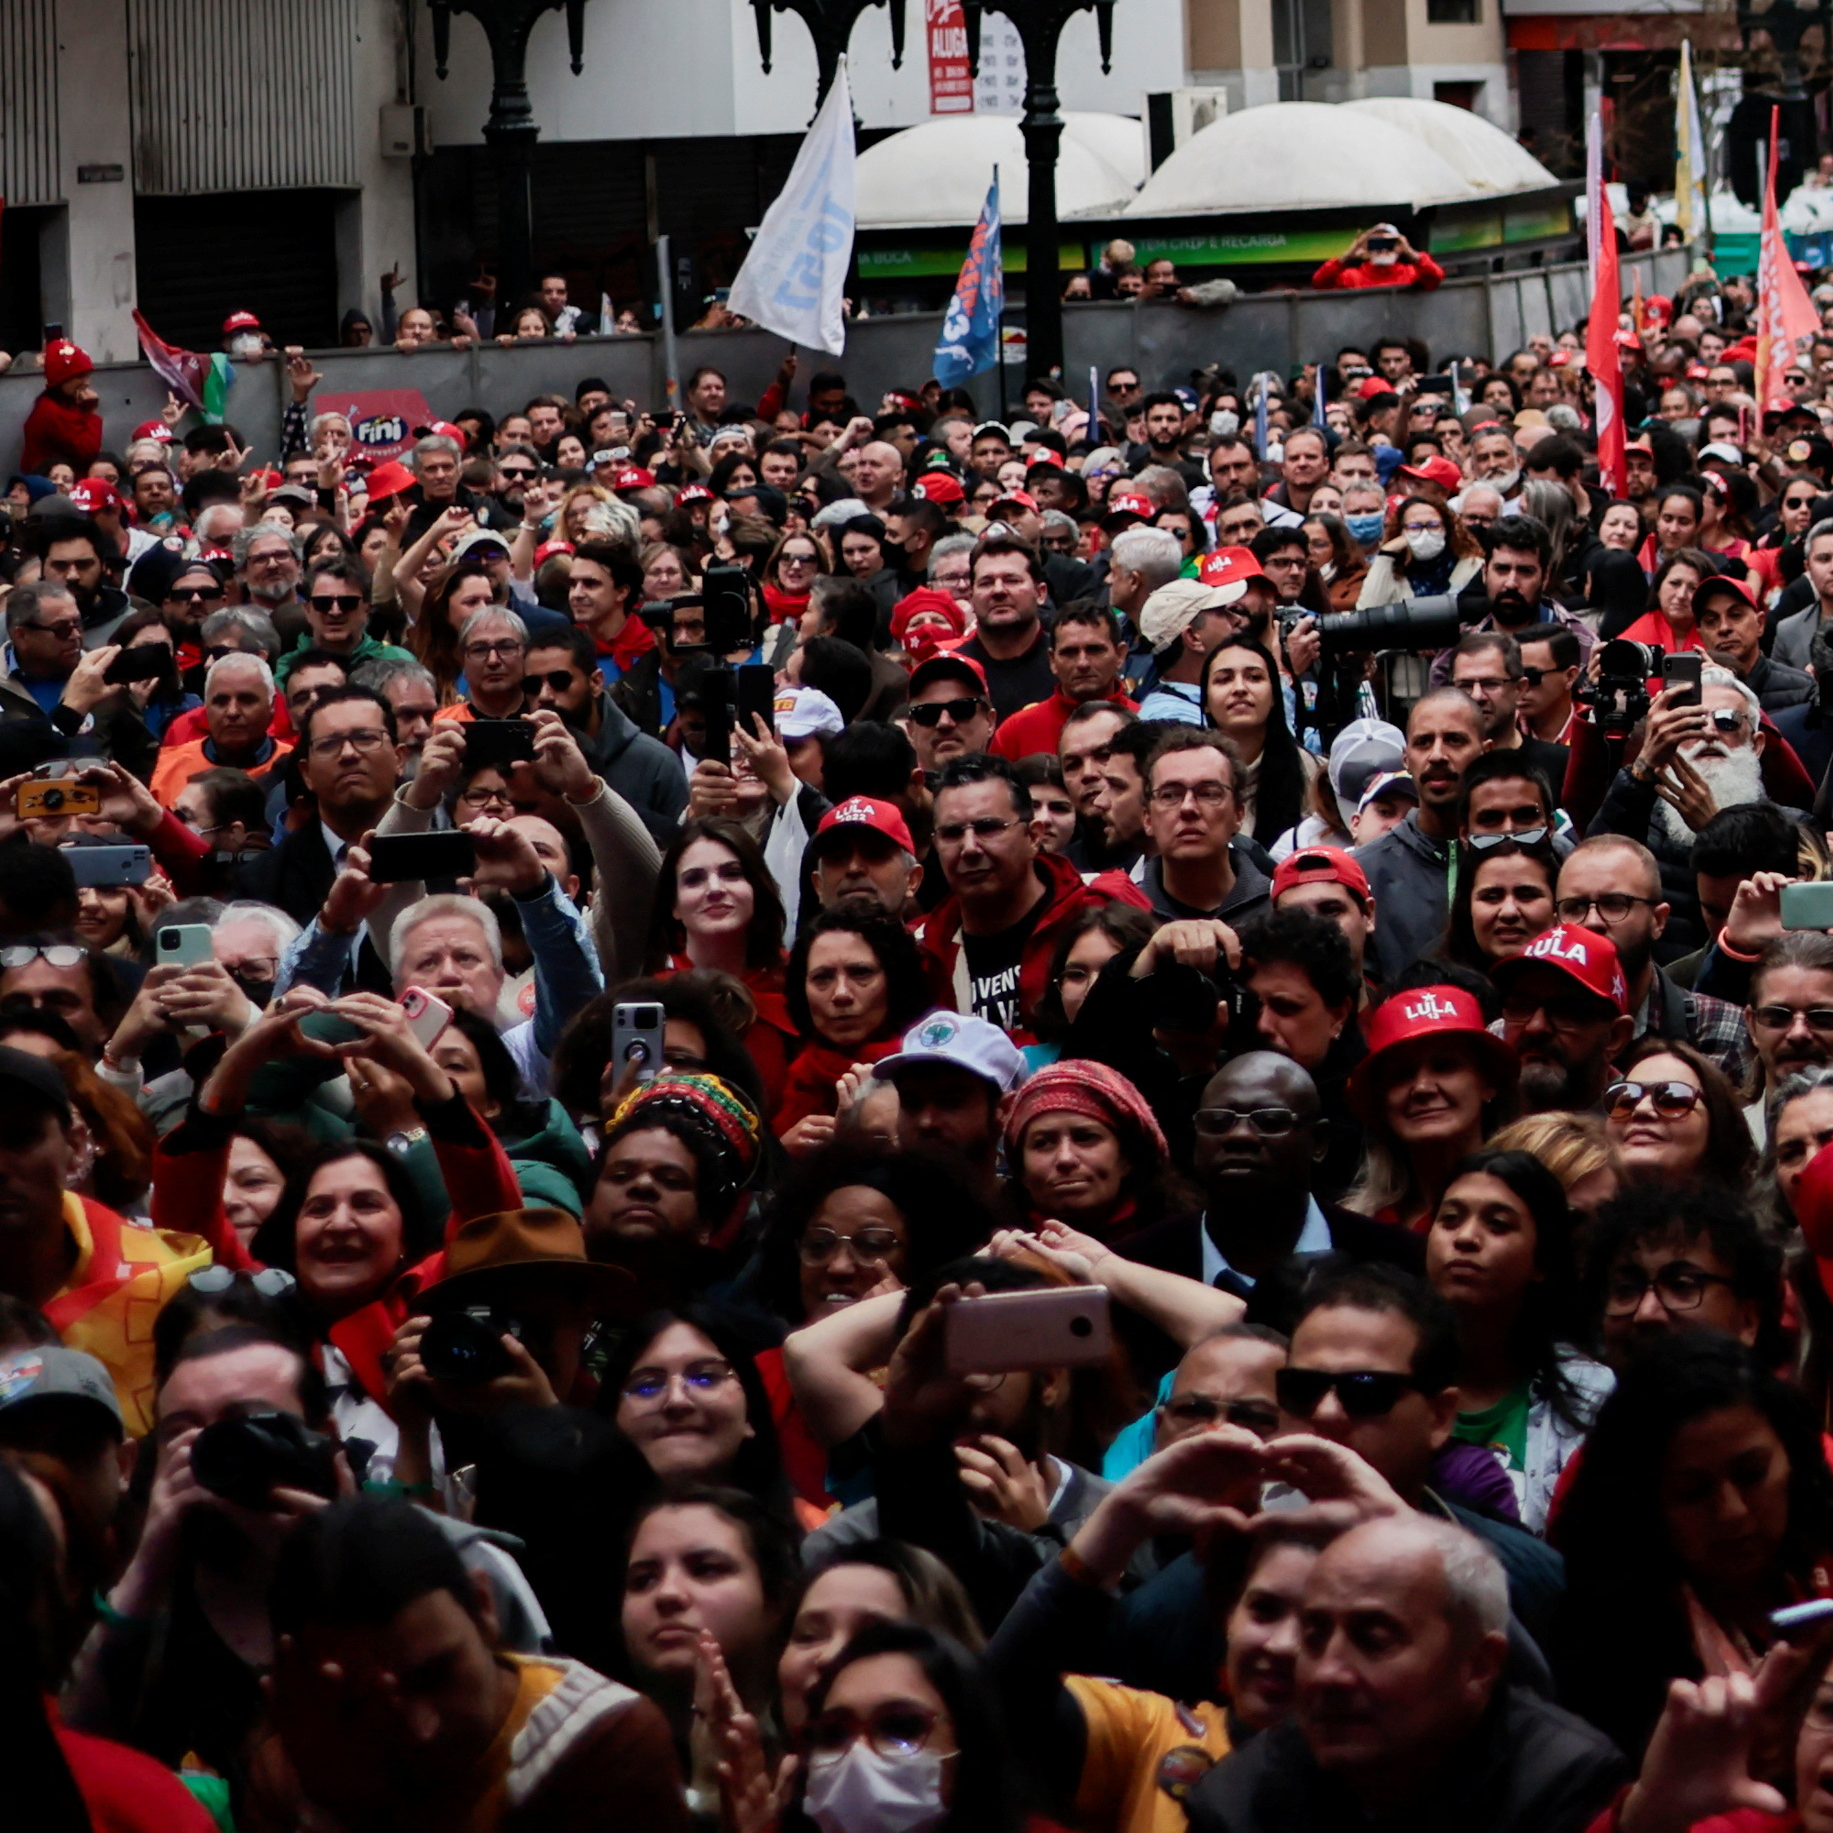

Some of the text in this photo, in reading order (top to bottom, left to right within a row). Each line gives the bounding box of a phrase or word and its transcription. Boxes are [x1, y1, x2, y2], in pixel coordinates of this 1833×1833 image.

[368, 416, 402, 444] Fini
[69, 488, 92, 501] ULA
[834, 803, 875, 821] LULA
[1525, 938, 1588, 967] LULA
[1404, 1000, 1457, 1019] LULA
